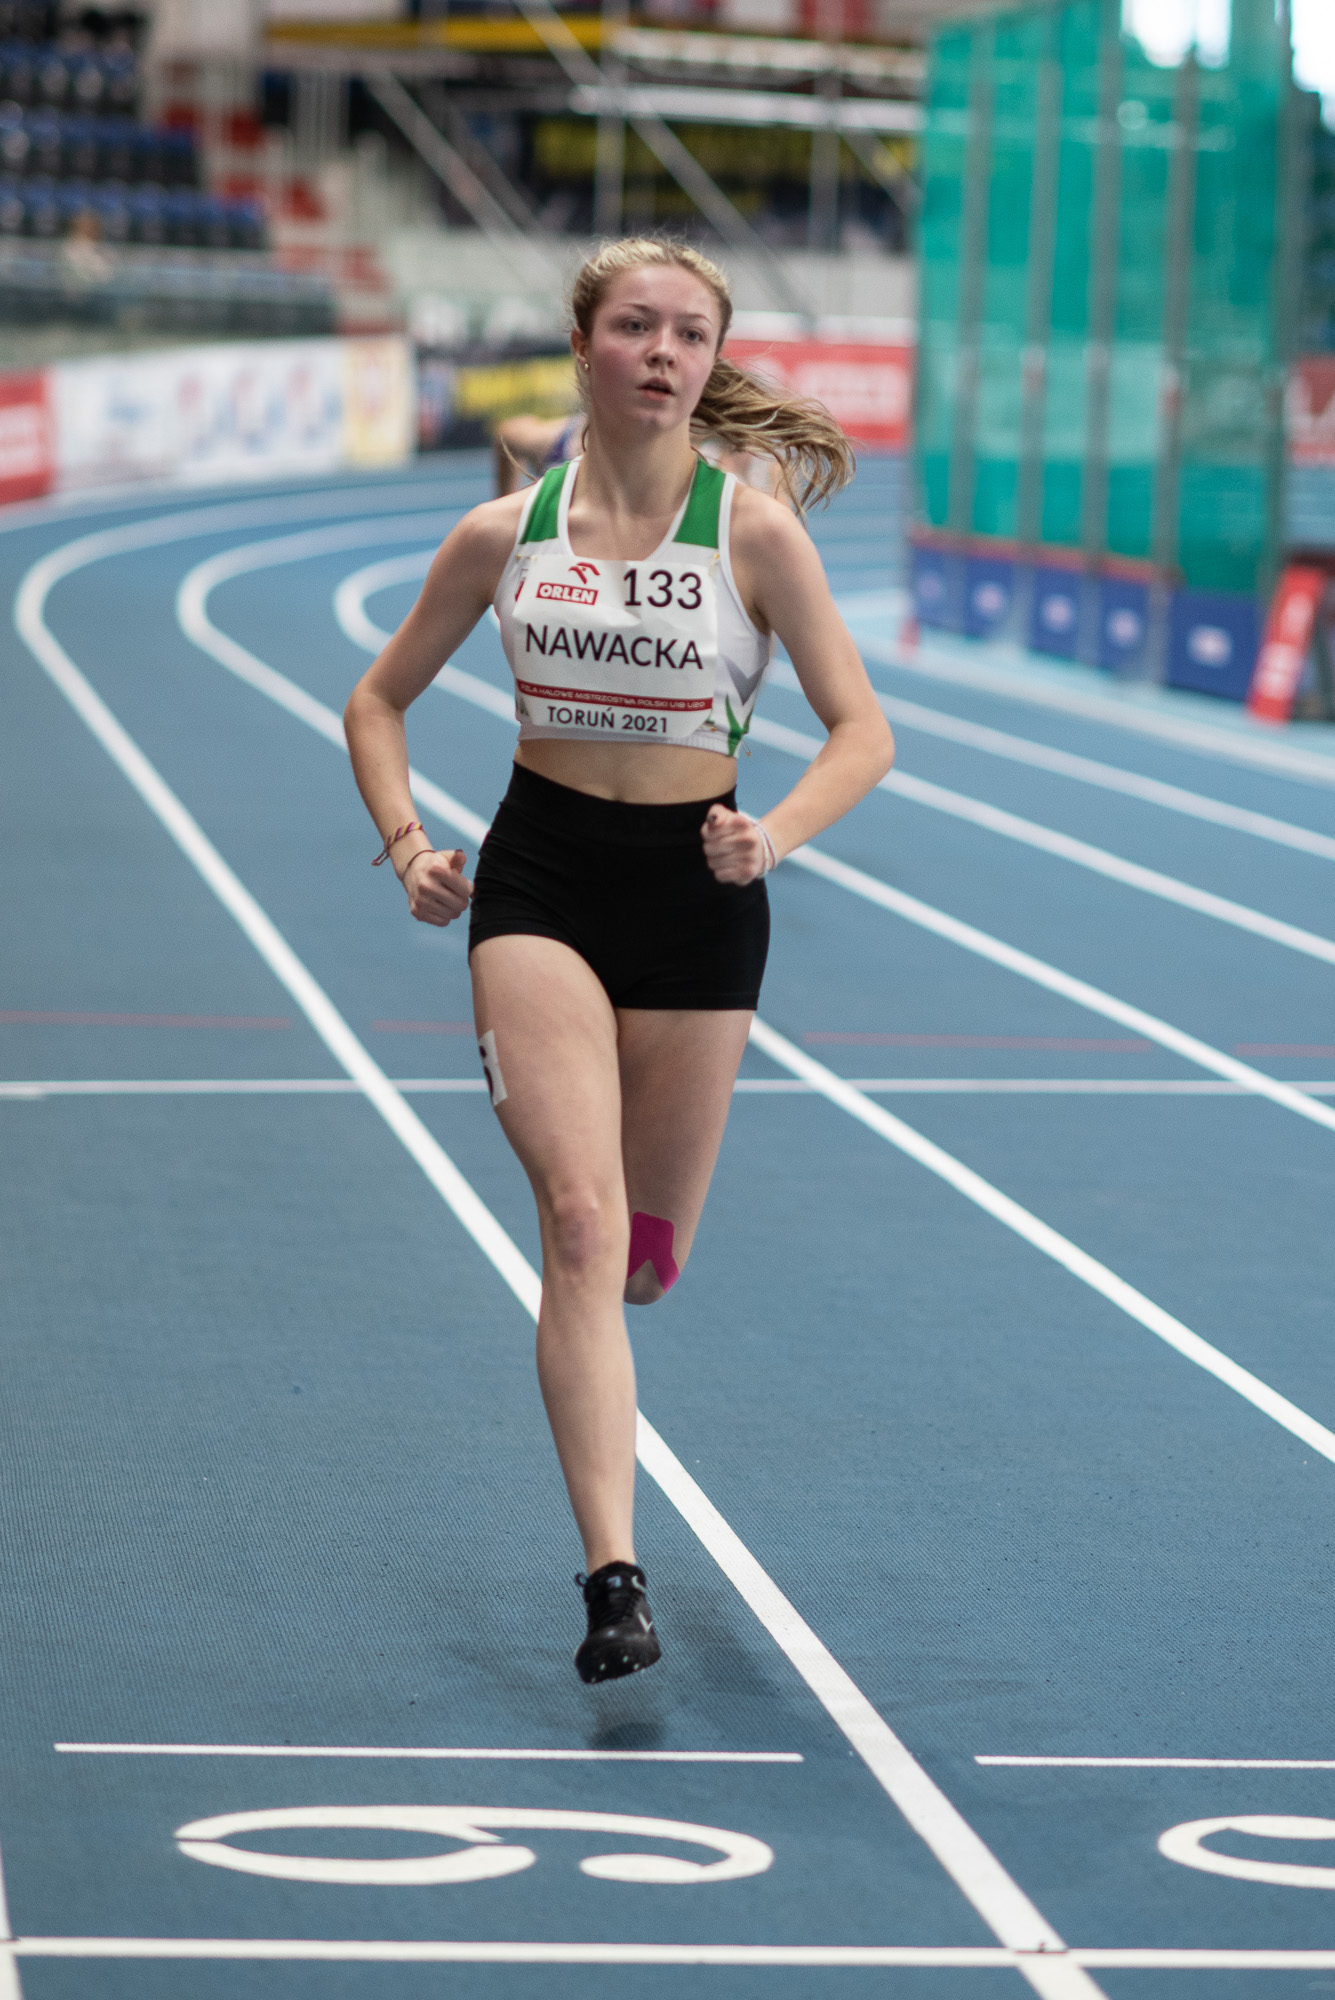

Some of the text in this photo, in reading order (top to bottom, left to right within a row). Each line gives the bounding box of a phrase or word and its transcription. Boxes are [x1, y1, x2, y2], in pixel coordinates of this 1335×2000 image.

[538, 584, 597, 604] ORLEN
[623, 568, 702, 610] 133
[525, 622, 704, 670] NAWACKA
[547, 705, 668, 734] TORUŃ 2021
